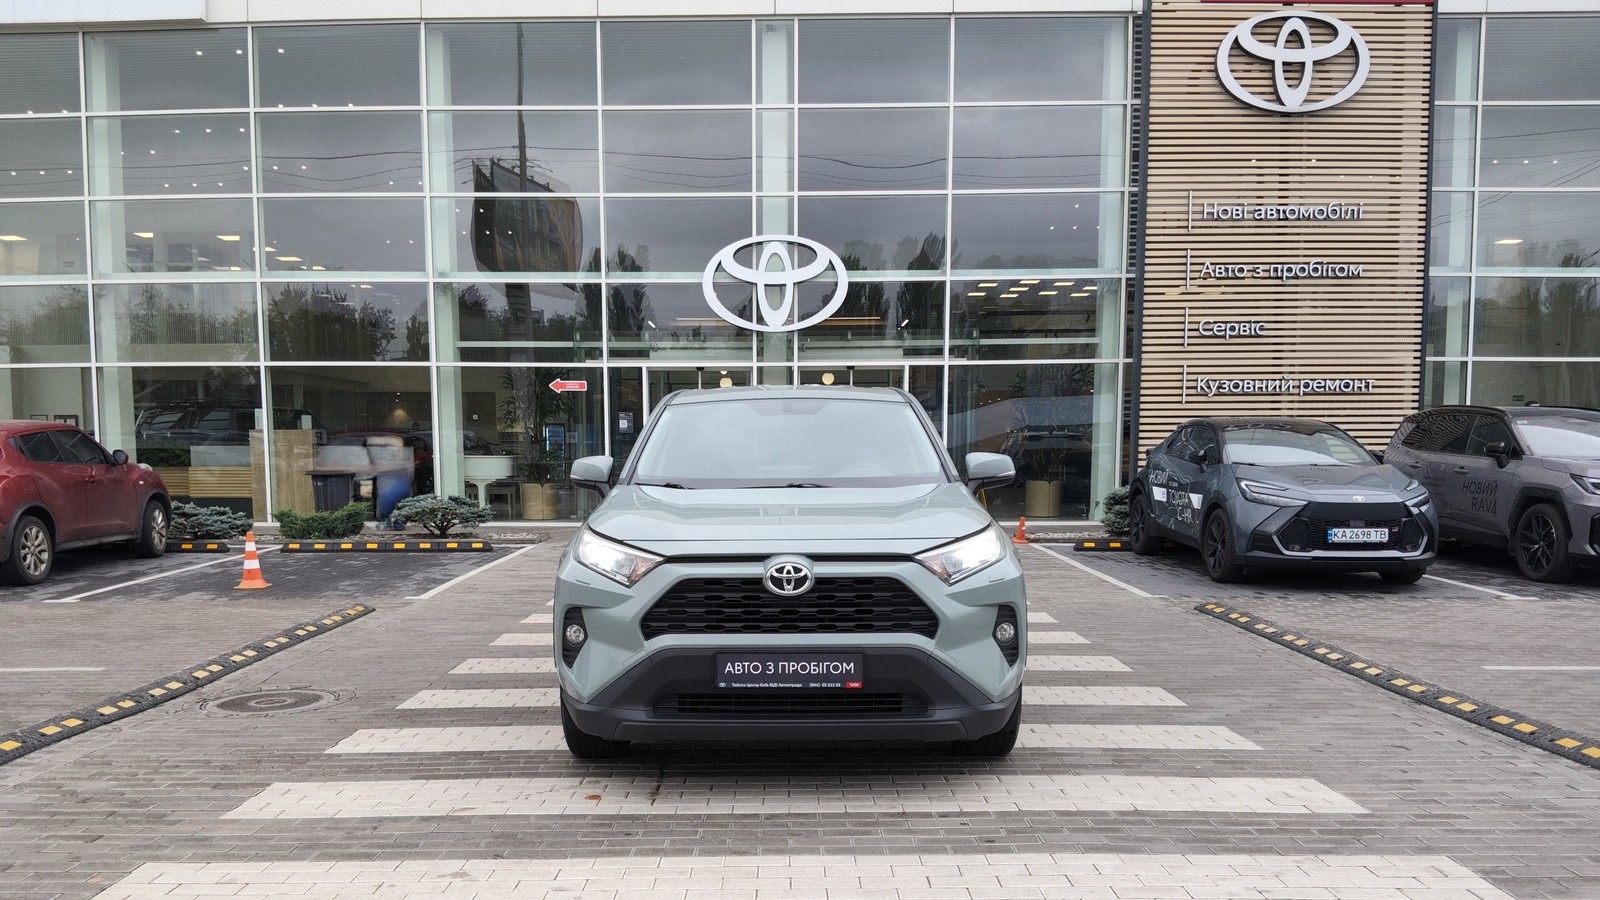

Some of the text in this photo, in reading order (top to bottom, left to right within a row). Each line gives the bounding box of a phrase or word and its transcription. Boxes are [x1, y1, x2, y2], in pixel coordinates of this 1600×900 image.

[1203, 202, 1363, 219] Нові автомобілі
[1200, 260, 1363, 282] Авто з пробігом
[1199, 319, 1265, 340] Сервіс
[1197, 376, 1376, 397] Кузовний ремонт
[1461, 480, 1498, 496] НОВИЙ
[1471, 497, 1498, 517] RAV4
[1333, 530, 1387, 540] KA 2698 TB
[724, 662, 762, 674] АВТО
[778, 662, 855, 674] ПРОБІГОМ
